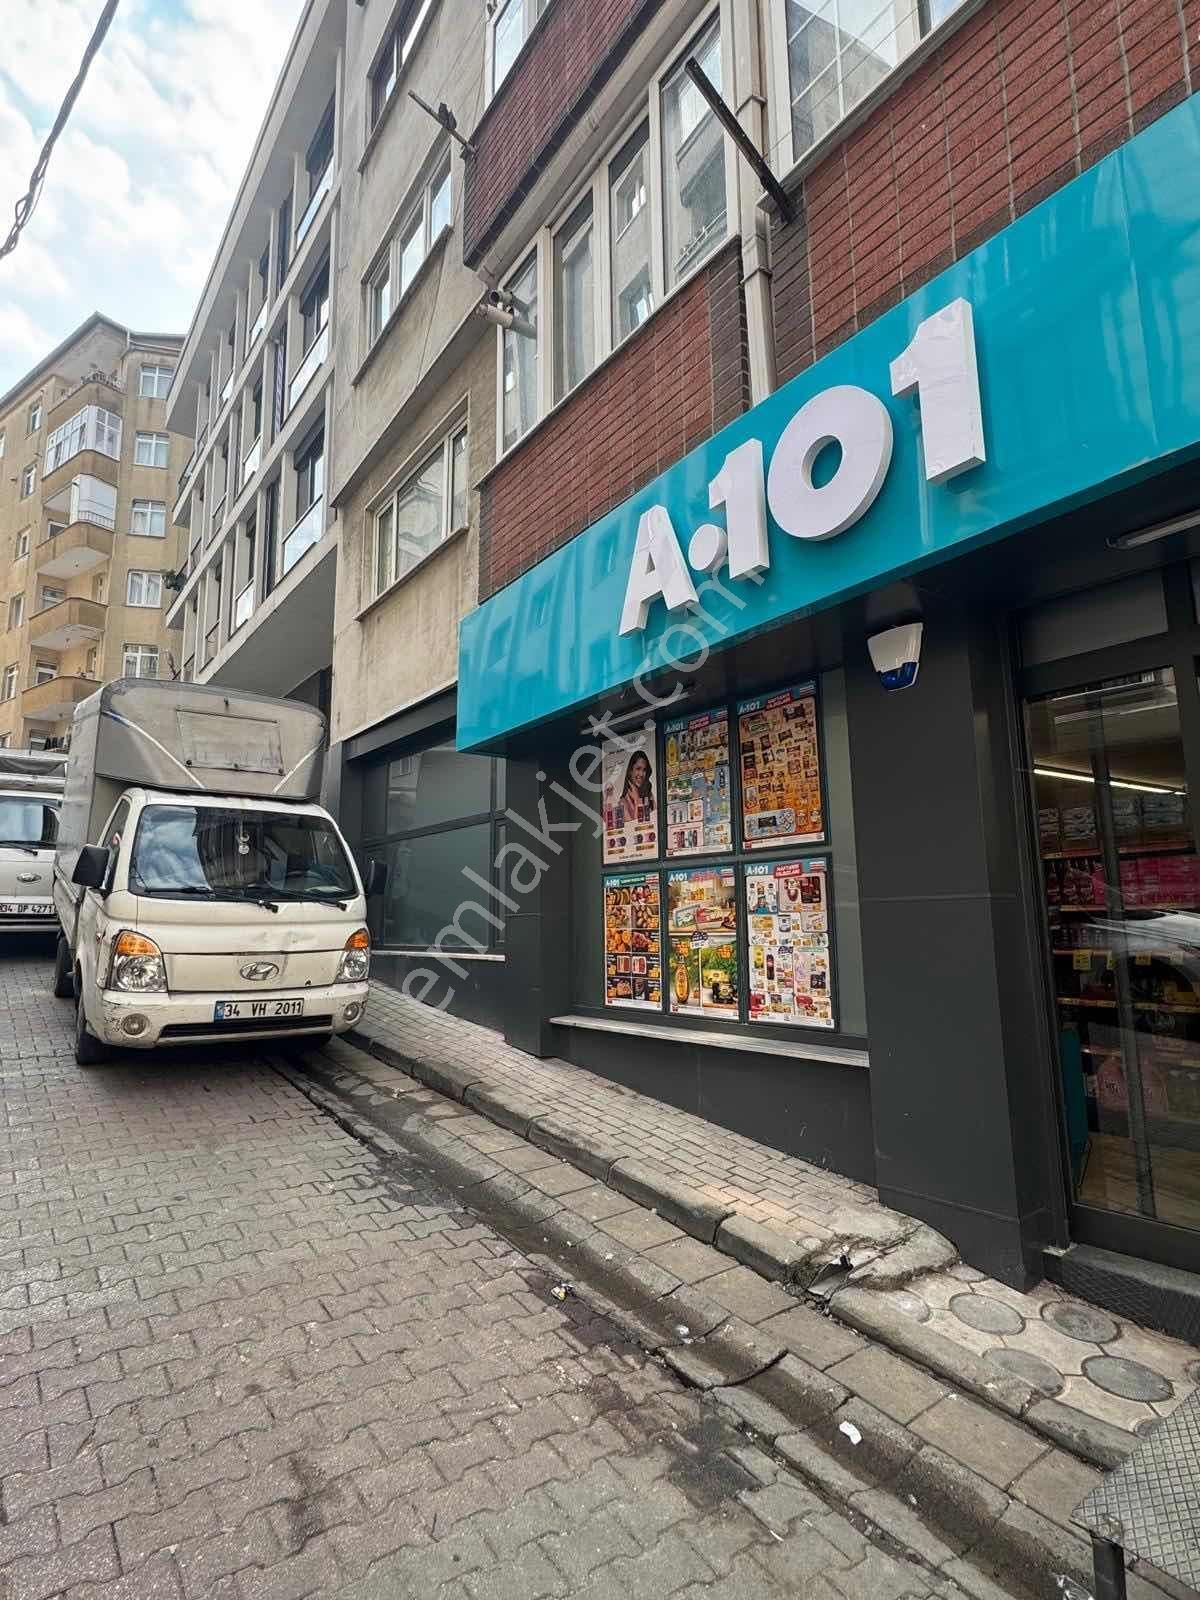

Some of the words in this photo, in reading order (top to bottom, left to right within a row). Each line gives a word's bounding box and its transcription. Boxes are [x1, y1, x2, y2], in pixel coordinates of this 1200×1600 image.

[224, 1004, 240, 1017] 34
[252, 1002, 267, 1016] VH
[275, 1001, 302, 1015] 2011
